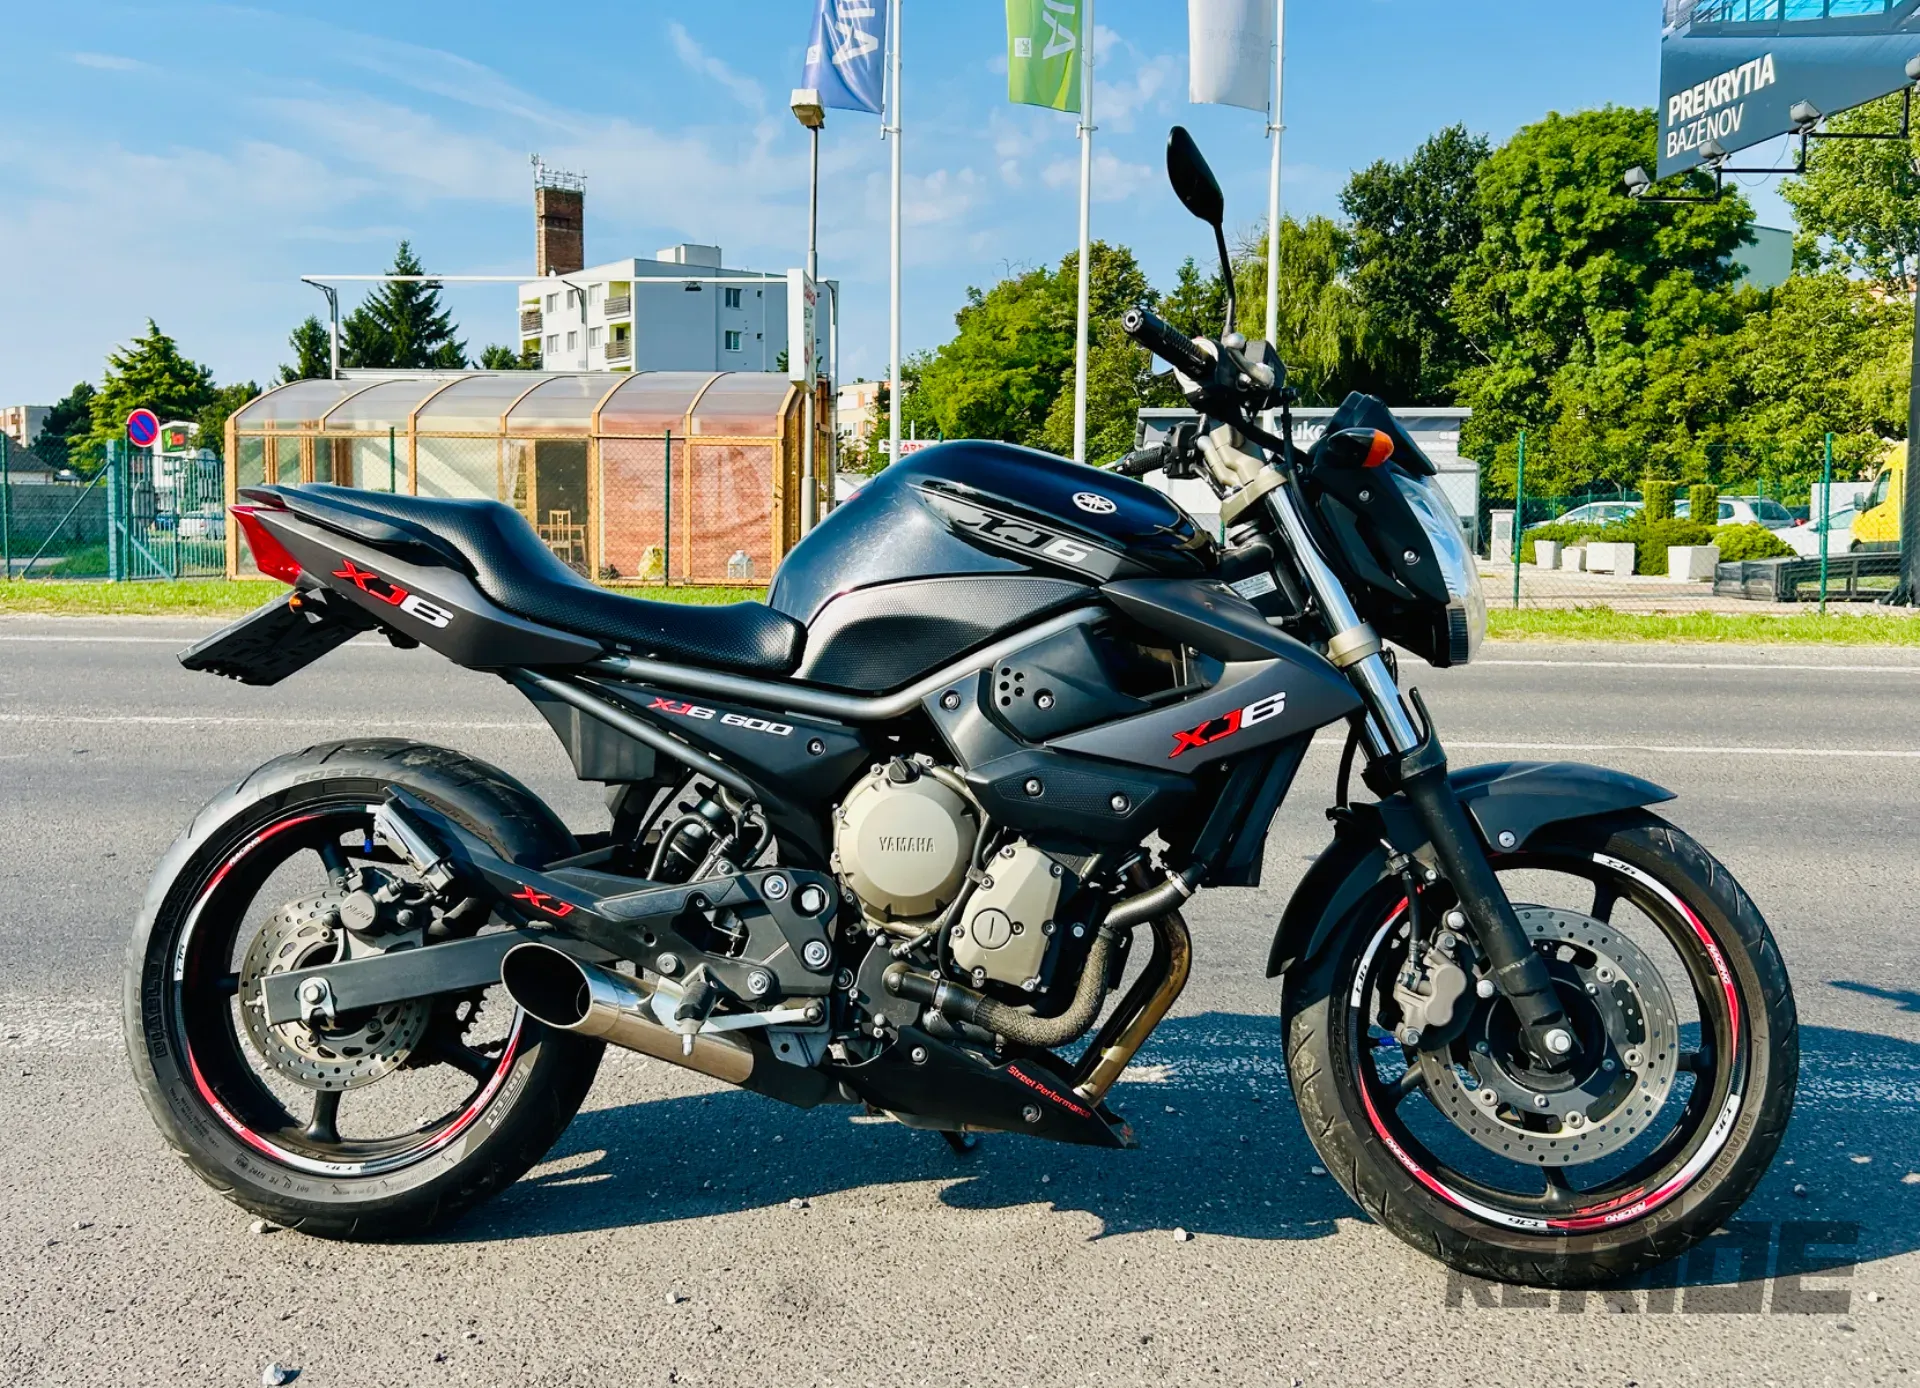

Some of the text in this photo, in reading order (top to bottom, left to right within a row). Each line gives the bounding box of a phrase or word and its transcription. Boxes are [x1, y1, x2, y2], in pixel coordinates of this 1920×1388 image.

[1667, 52, 1776, 127] PREKRYTIA
[1666, 103, 1744, 158] BAZÉNOV
[956, 512, 1094, 563] XJ6
[331, 558, 455, 628] XJ6
[646, 696, 794, 736] XJ6 600
[1168, 691, 1287, 759] XJ6
[879, 836, 936, 853] YAMAHA
[511, 885, 575, 917] XJ
[1705, 943, 1730, 984] RACING
[147, 962, 169, 1059] DIABLO
[486, 1062, 531, 1130] PIRELLI
[1007, 1064, 1092, 1120] Street Performance
[1385, 1137, 1421, 1172] RACING
[1696, 1111, 1757, 1193] DIABLO
[1604, 1200, 1647, 1223] RACING
